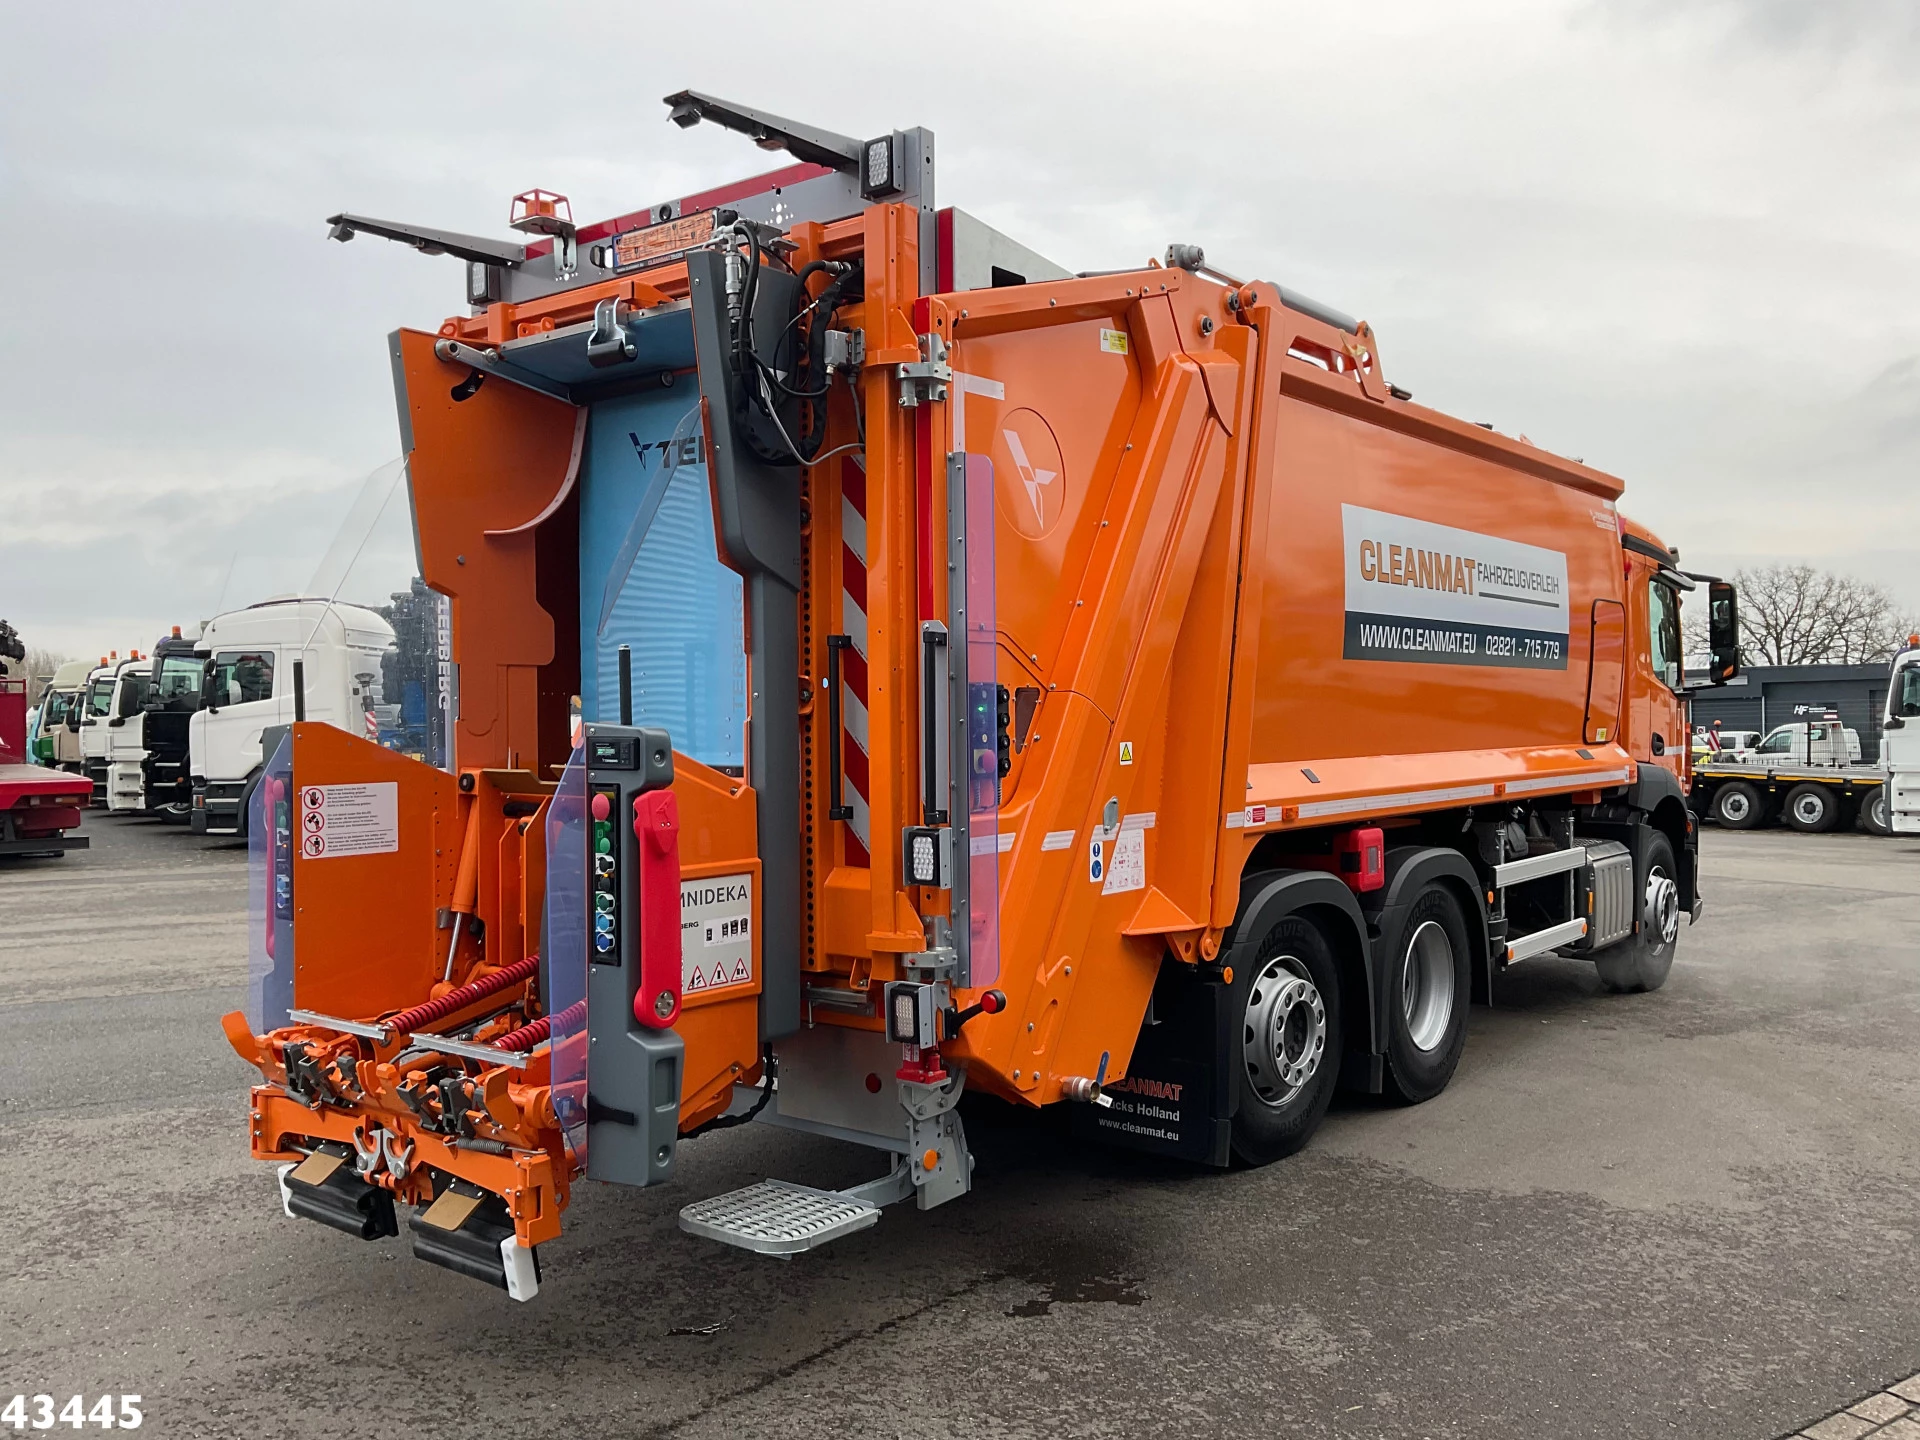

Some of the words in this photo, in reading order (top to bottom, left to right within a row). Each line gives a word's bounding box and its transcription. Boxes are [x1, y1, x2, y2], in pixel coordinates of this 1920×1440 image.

[1360, 539, 1475, 595] CLEANMAT
[1477, 562, 1560, 594] FAHRZEUGVERLEIH
[1360, 623, 1477, 654] WWW.CLEANMAT.EU
[1485, 635, 1516, 657] 02821
[1524, 639, 1541, 658] 715
[1543, 641, 1560, 660] 779
[1794, 705, 1809, 715] HF
[1107, 1076, 1182, 1101] EANMAT
[1137, 1103, 1180, 1122] Holland
[1098, 1118, 1179, 1141] www.cleanmat.eu
